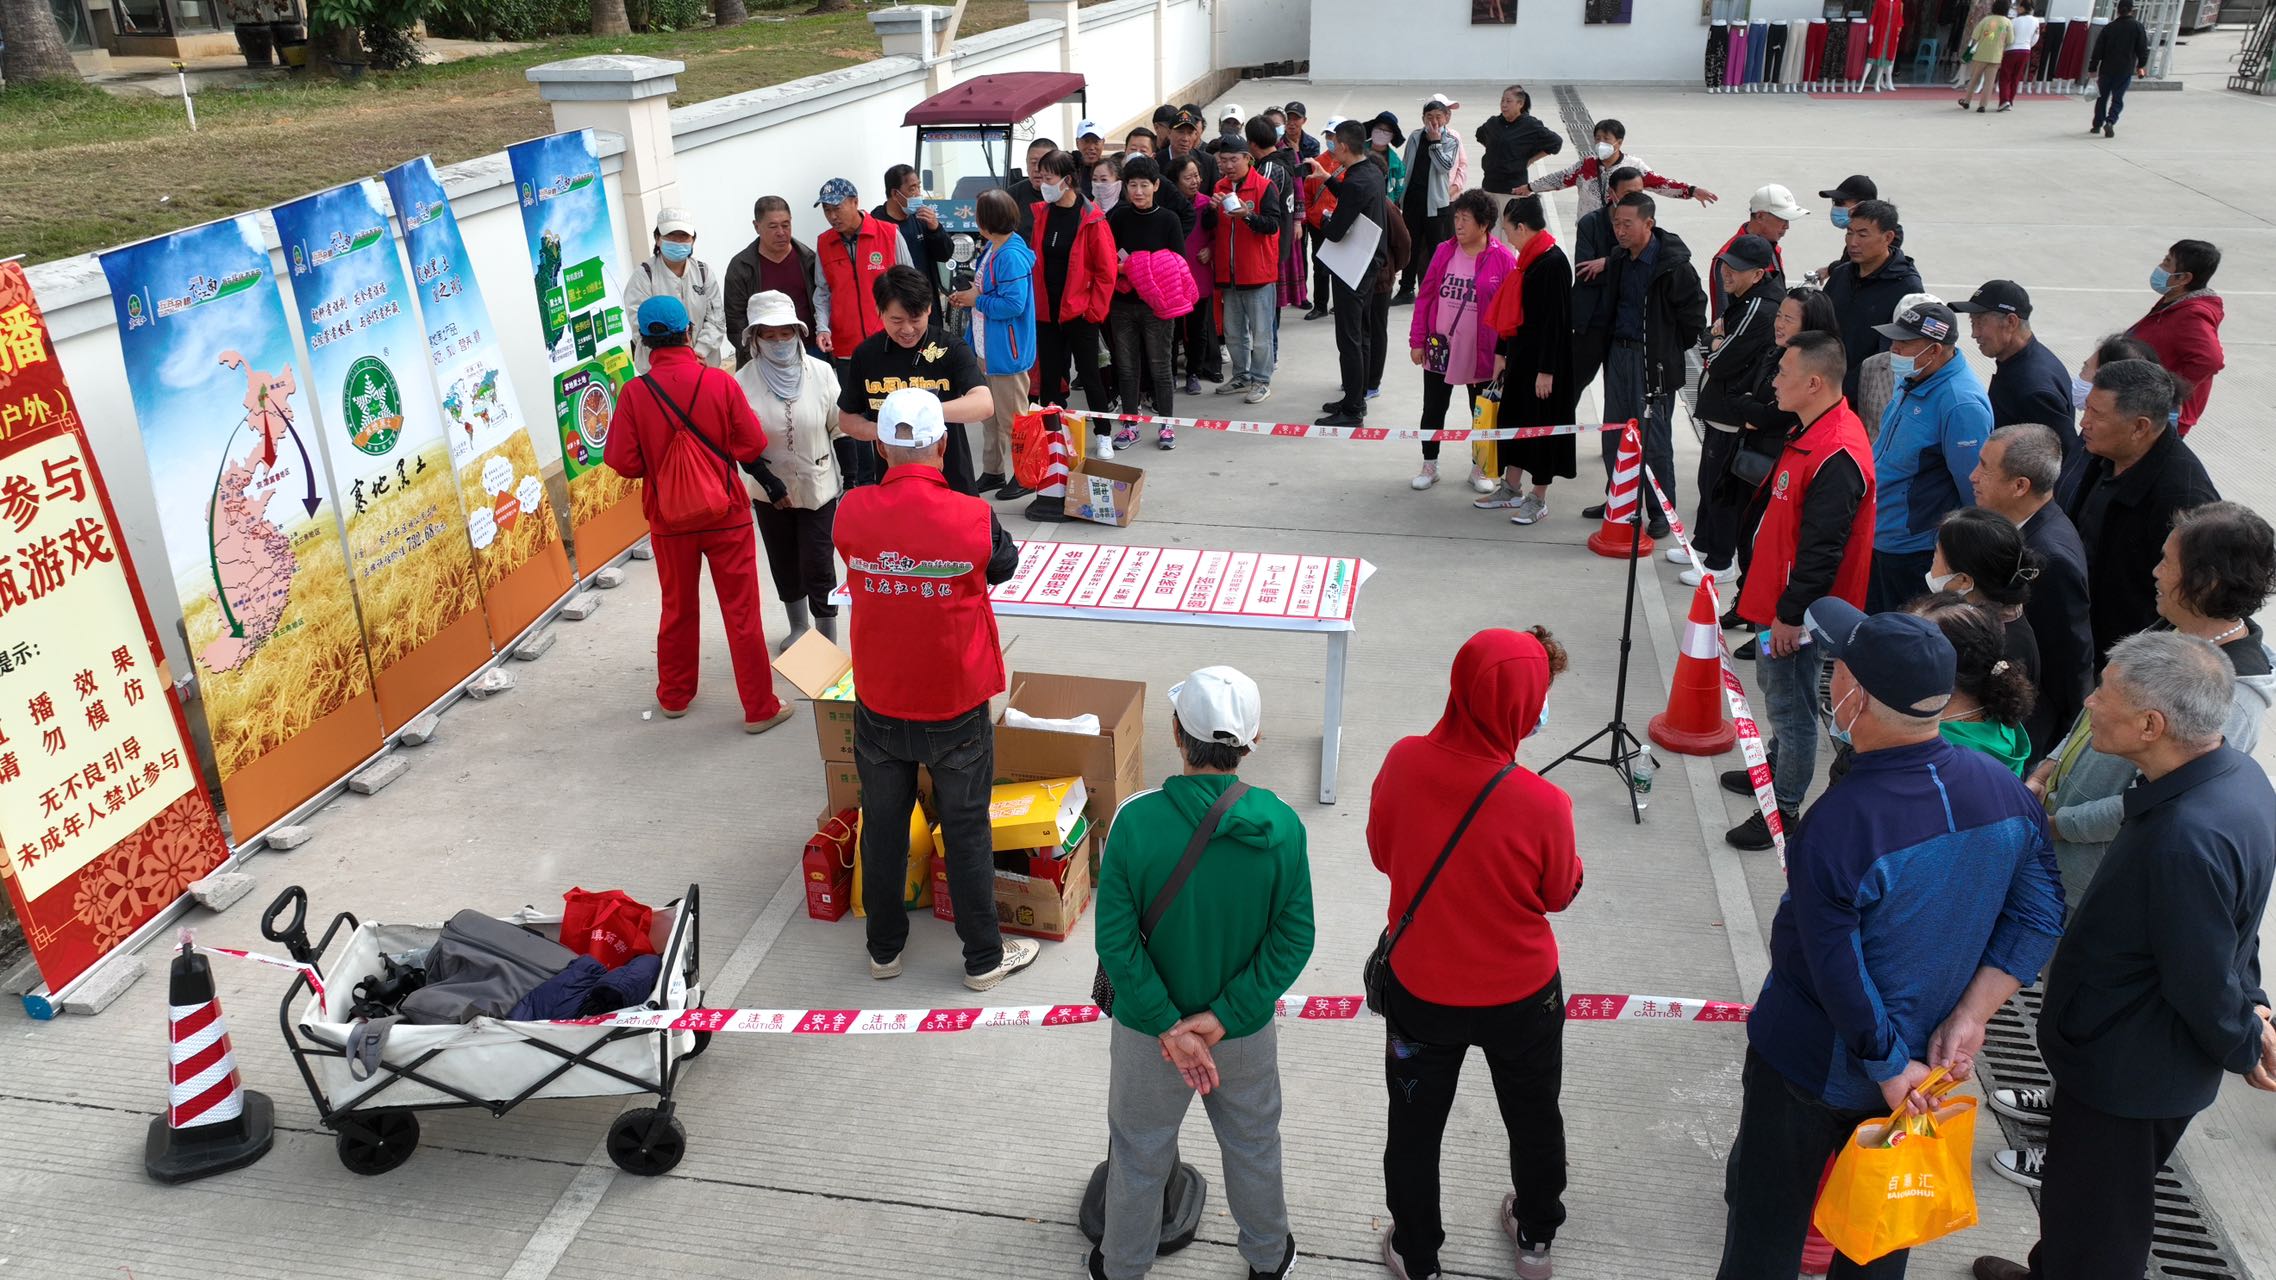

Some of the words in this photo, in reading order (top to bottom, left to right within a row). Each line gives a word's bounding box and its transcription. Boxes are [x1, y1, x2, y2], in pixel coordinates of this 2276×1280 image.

[350, 454, 427, 519] 寒地黑土
[0, 454, 87, 533] 参与
[1038, 549, 1086, 597] 没把握住机会
[1152, 562, 1186, 595] 回家吃饭
[1254, 563, 1288, 604] 有请下一位
[1184, 575, 1218, 608] 趣味问答
[38, 735, 141, 819] 无不良引导
[17, 748, 180, 872] 未成年人禁止参与
[1315, 997, 1352, 1011] 安全
[1577, 996, 1615, 1011] 安全
[1642, 1000, 1684, 1014] 注意
[688, 1010, 725, 1023] 安全
[934, 1010, 970, 1023] 安全
[993, 1008, 1031, 1021] 注意
[1058, 1004, 1094, 1018] 安全
[1308, 1009, 1348, 1018] SAFE
[1569, 1008, 1611, 1018] SAFE
[1633, 1010, 1683, 1019] CAUTION
[1704, 1012, 1748, 1022] SAFE
[1714, 1004, 1752, 1018] 安全
[679, 1019, 717, 1030] SAFE
[747, 1012, 786, 1024] 注意
[812, 1012, 847, 1026] 安全
[871, 1012, 909, 1025] 注意
[984, 1018, 1031, 1028] CAUTION
[1049, 1014, 1091, 1024] SAFE
[737, 1021, 784, 1031] CAUTION
[803, 1022, 841, 1032] SAFE
[861, 1022, 907, 1031] CAUTION
[926, 1020, 965, 1031] SAFE
